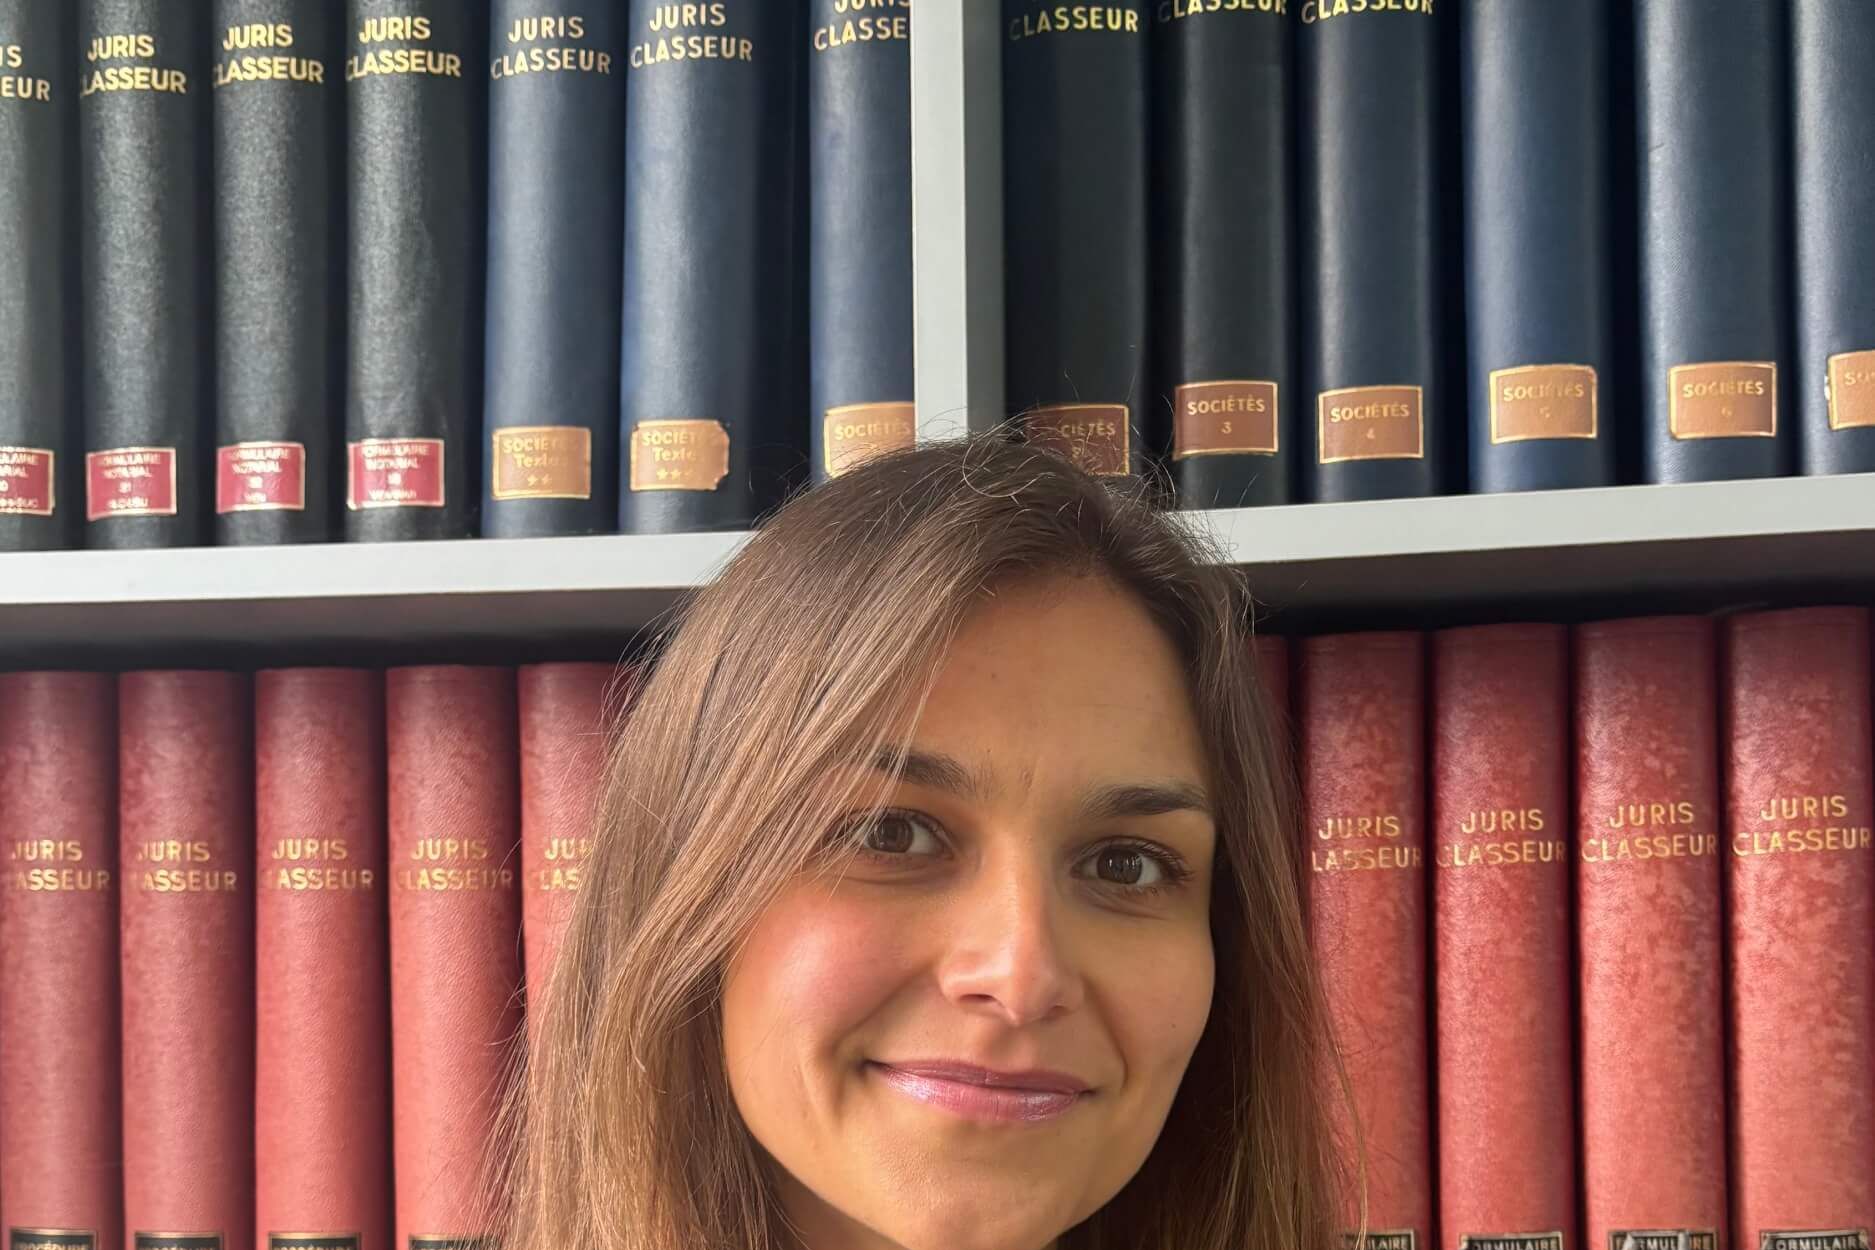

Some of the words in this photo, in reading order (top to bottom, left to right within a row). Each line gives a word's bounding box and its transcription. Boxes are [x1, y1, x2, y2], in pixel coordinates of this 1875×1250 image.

[358, 16, 431, 43] JURIS
[508, 16, 584, 42] JURIS
[649, 3, 726, 31] JURIS
[1009, 6, 1139, 41] CLASSEUR
[87, 34, 155, 61] JURIS
[223, 24, 293, 50] JURIS
[491, 48, 611, 80] CLASSEUR
[630, 36, 753, 68] CLASSEUR
[82, 67, 187, 96] LASSEUR
[1222, 421, 1232, 434] 3
[1609, 802, 1694, 828] JURIS
[1761, 795, 1848, 821] JURIS
[1318, 816, 1400, 840] JURIS
[1461, 809, 1544, 834] JURIS
[12, 840, 83, 861] JURIS
[137, 840, 210, 862] JURIS
[272, 838, 348, 860] JURIS
[411, 838, 488, 860] JURIS
[1582, 834, 1716, 863] CLASSEUR
[1732, 827, 1871, 857] CLASSEUR
[16, 868, 110, 890] ASSEUR
[144, 869, 237, 892] ASSEUR
[406, 867, 513, 890] LASSEUR
